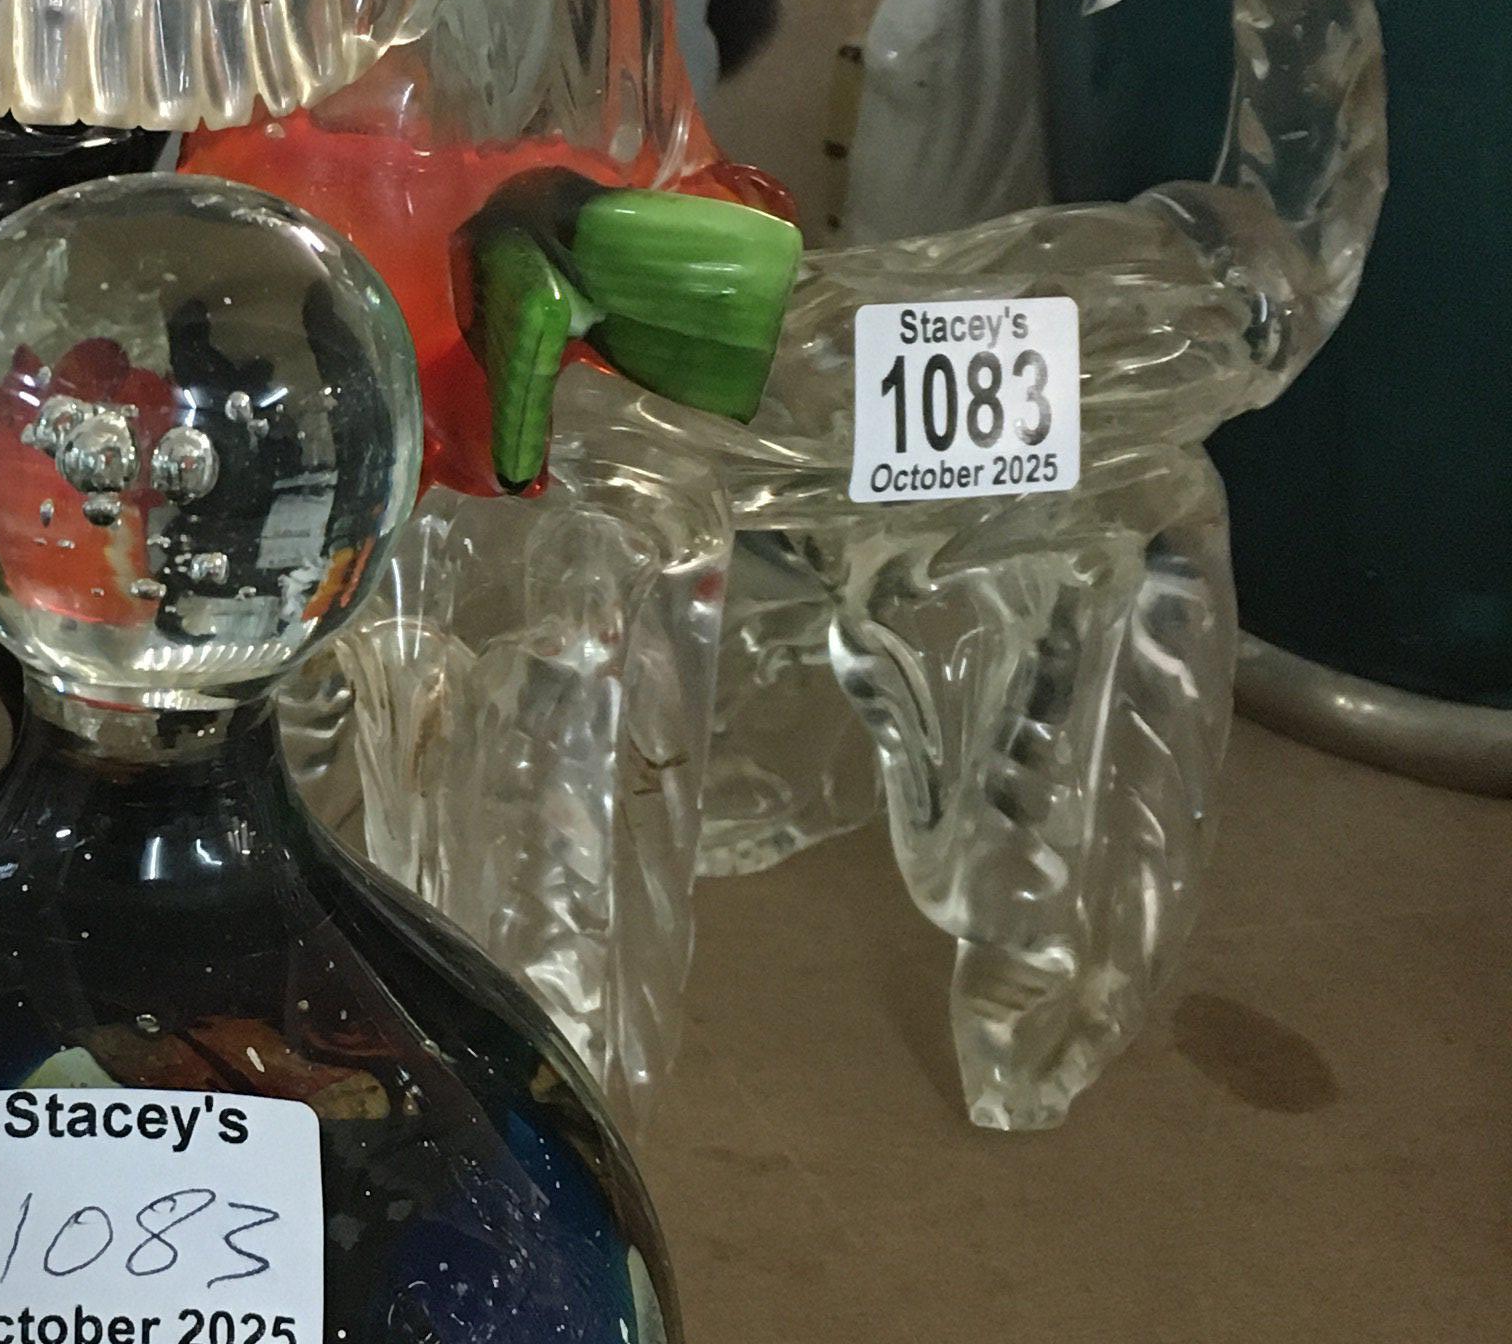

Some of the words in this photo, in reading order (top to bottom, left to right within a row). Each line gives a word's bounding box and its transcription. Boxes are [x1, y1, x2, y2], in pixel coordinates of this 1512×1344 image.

[900, 306, 1029, 348] Stacey's
[881, 349, 1052, 453] 1083
[870, 460, 985, 493] October
[992, 453, 1058, 485] 2025
[4, 1091, 249, 1153] Stacey's
[0, 1188, 280, 1289] 1083
